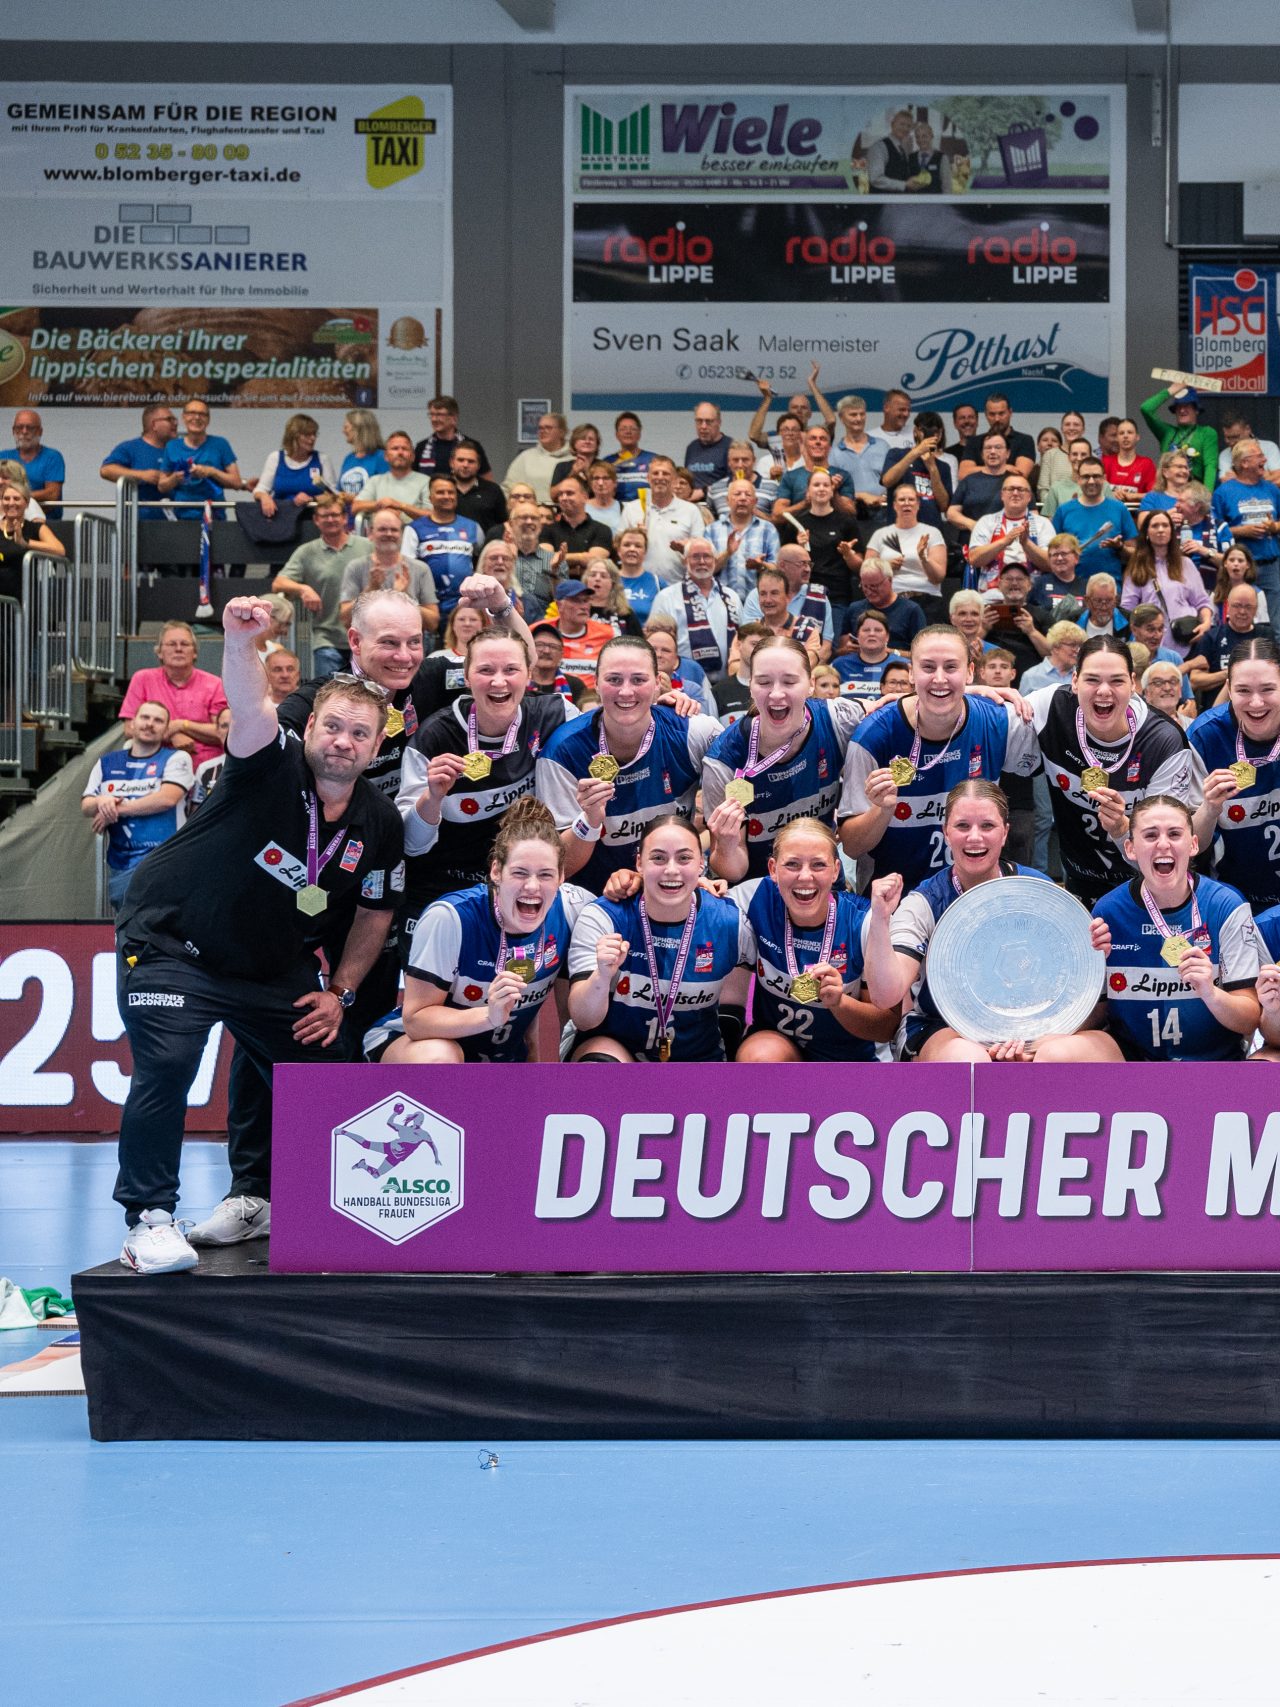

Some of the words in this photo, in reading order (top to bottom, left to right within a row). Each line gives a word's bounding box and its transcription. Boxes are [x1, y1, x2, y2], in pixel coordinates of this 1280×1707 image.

[7, 104, 146, 120] GEMEINSAM
[154, 102, 198, 121] FÜR
[206, 105, 243, 121] DIE
[251, 106, 337, 121] REGION
[11, 124, 28, 133] mit
[31, 124, 60, 133] Ihrem
[63, 124, 87, 133] Profi
[90, 124, 105, 133] für
[107, 125, 188, 135] Krankenfahrten,
[191, 126, 280, 135] Flughafentransfer
[282, 127, 300, 135] und
[304, 126, 325, 135] Taxi
[358, 120, 433, 132] BLOMBERGER
[661, 102, 823, 156] Wiele
[95, 143, 109, 160] 0
[114, 143, 141, 160] 52
[147, 143, 173, 160] 35
[371, 137, 419, 166] TAXI
[701, 154, 756, 172] besser
[759, 154, 839, 173] einkaufen
[44, 166, 301, 185] www.blomberger-taxi.de
[94, 226, 135, 244] DIE
[603, 221, 714, 265] radio
[785, 221, 895, 265] radio
[967, 221, 1077, 265] radio
[33, 250, 308, 272] BAUWERKSSANIERER
[648, 265, 714, 284] LIPPE
[831, 265, 895, 284] LIPPE
[1013, 265, 1078, 284] LIPPE
[32, 283, 97, 296] Sicherheit
[100, 284, 124, 296] und
[128, 284, 195, 297] Werterhalt
[199, 284, 218, 297] für
[220, 284, 245, 297] Ihre
[248, 284, 309, 298] Immobilie
[1194, 296, 1267, 336] HSG
[30, 328, 72, 351] Die
[77, 328, 184, 351] Bäckerei
[187, 329, 248, 351] Ihrer
[592, 327, 662, 353] Sven
[673, 326, 740, 353] Saak
[758, 332, 880, 354] Malermeister
[1194, 336, 1267, 358] Blomberg
[900, 322, 1062, 392] Potthast
[1194, 352, 1233, 372] Lippe
[30, 356, 155, 383] lippischen
[160, 357, 371, 384] Brotspezialitäten
[757, 365, 776, 381] 73
[779, 365, 798, 380] 52
[1220, 375, 1266, 390] ndball
[28, 392, 54, 402] Infos
[55, 391, 74, 402] auf
[168, 392, 191, 402] oder
[140, 999, 185, 1008] CONTACT
[777, 1003, 814, 1040] 22
[1147, 1007, 1183, 1047] 14
[534, 1110, 1170, 1220] DEUTSCHER
[381, 1176, 451, 1194] ALSCO
[343, 1197, 392, 1207] HANDBALL
[394, 1197, 451, 1207] BUNDESLIGA
[378, 1208, 415, 1218] FRAUEN
